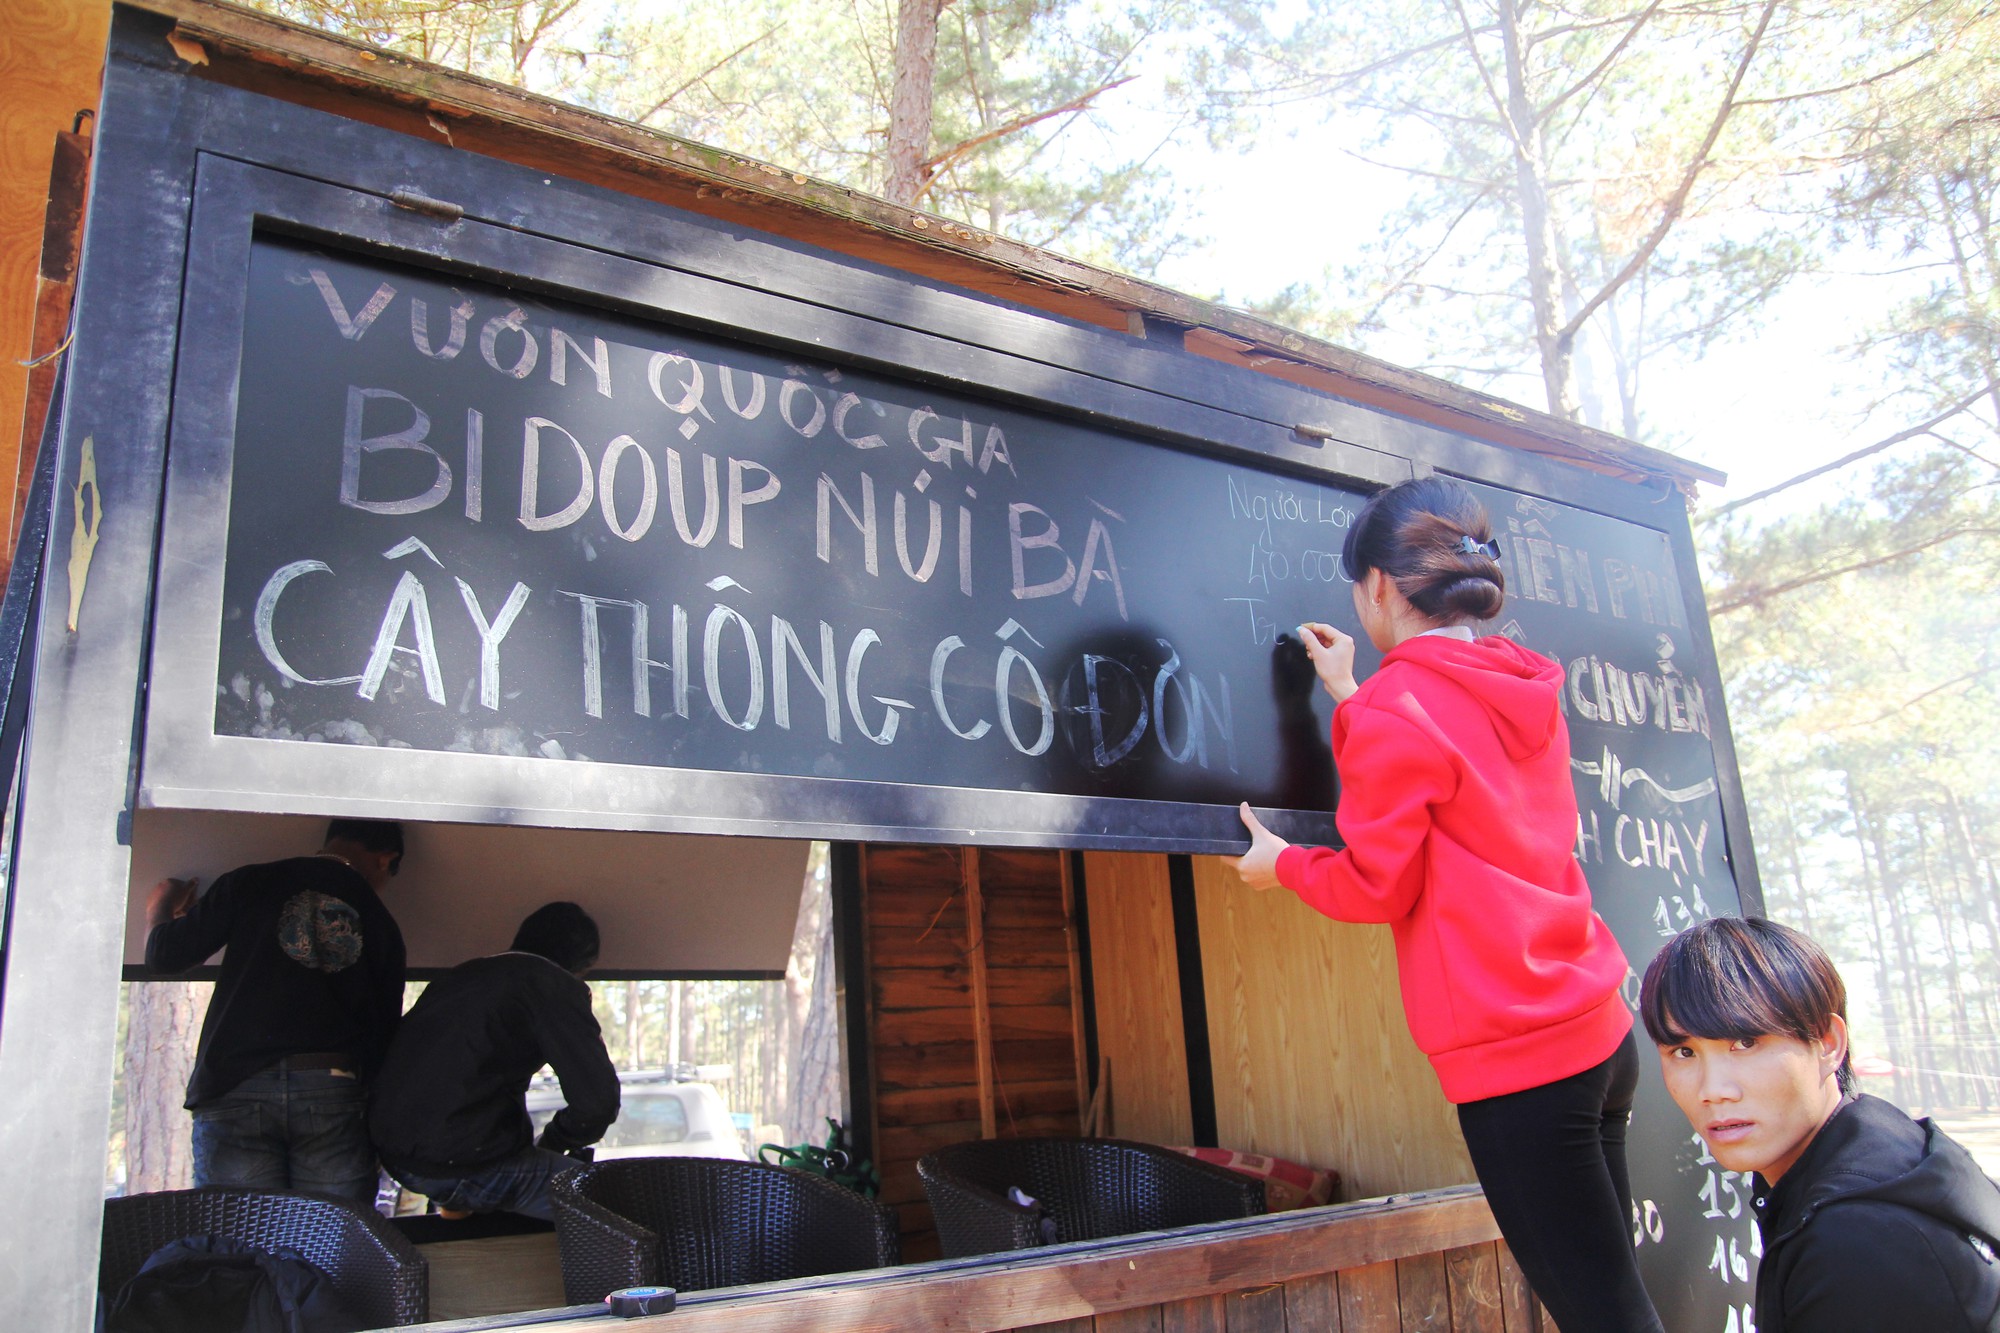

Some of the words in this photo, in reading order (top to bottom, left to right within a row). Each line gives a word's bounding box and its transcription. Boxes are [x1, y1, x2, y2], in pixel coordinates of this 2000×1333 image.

[340, 385, 484, 522] BI
[815, 468, 978, 598] NÚI
[1009, 496, 1129, 622] BÀ
[908, 405, 1017, 478] GIA
[254, 536, 533, 711] CÂY
[557, 575, 916, 746] THÔNG
[930, 617, 1055, 756] CÔ
[1614, 813, 1708, 888] CHẠY
